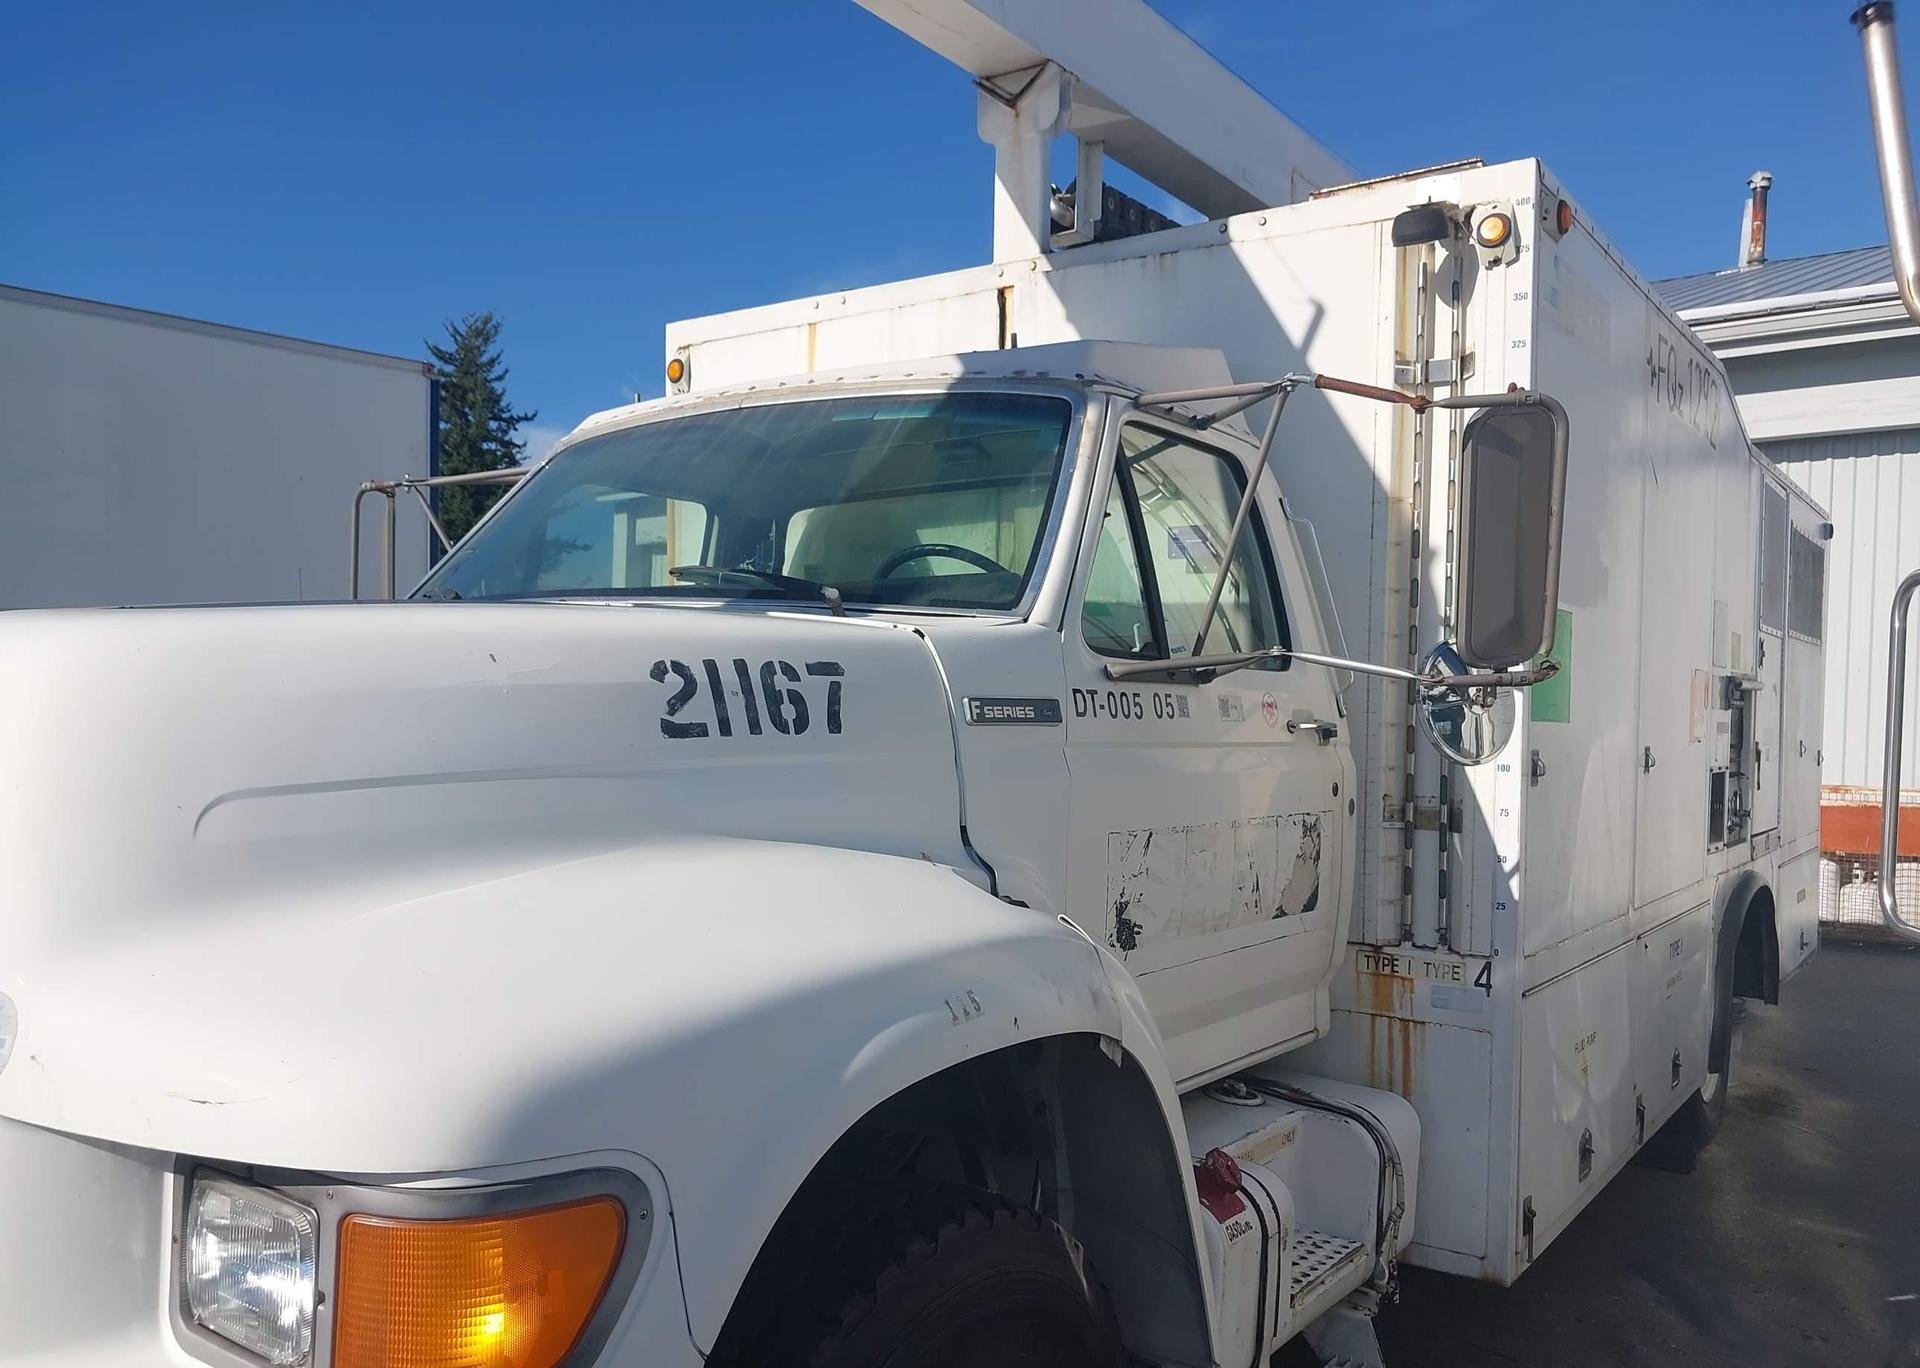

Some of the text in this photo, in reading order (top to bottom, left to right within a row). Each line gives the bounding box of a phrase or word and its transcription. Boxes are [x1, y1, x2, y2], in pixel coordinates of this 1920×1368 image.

[1513, 292, 1529, 301] 350
[1511, 340, 1527, 349] 325
[650, 659, 846, 738] 21167
[1072, 688, 1175, 721] DT-005 05
[970, 701, 981, 720] F
[983, 705, 1035, 719] SERIES
[1496, 764, 1511, 773] 100
[1499, 808, 1510, 817] 75
[1496, 855, 1507, 864] 50
[1495, 902, 1506, 911] 25
[1364, 955, 1400, 975] TYPE
[1424, 962, 1461, 981] TYPE
[1473, 961, 1493, 998] 4
